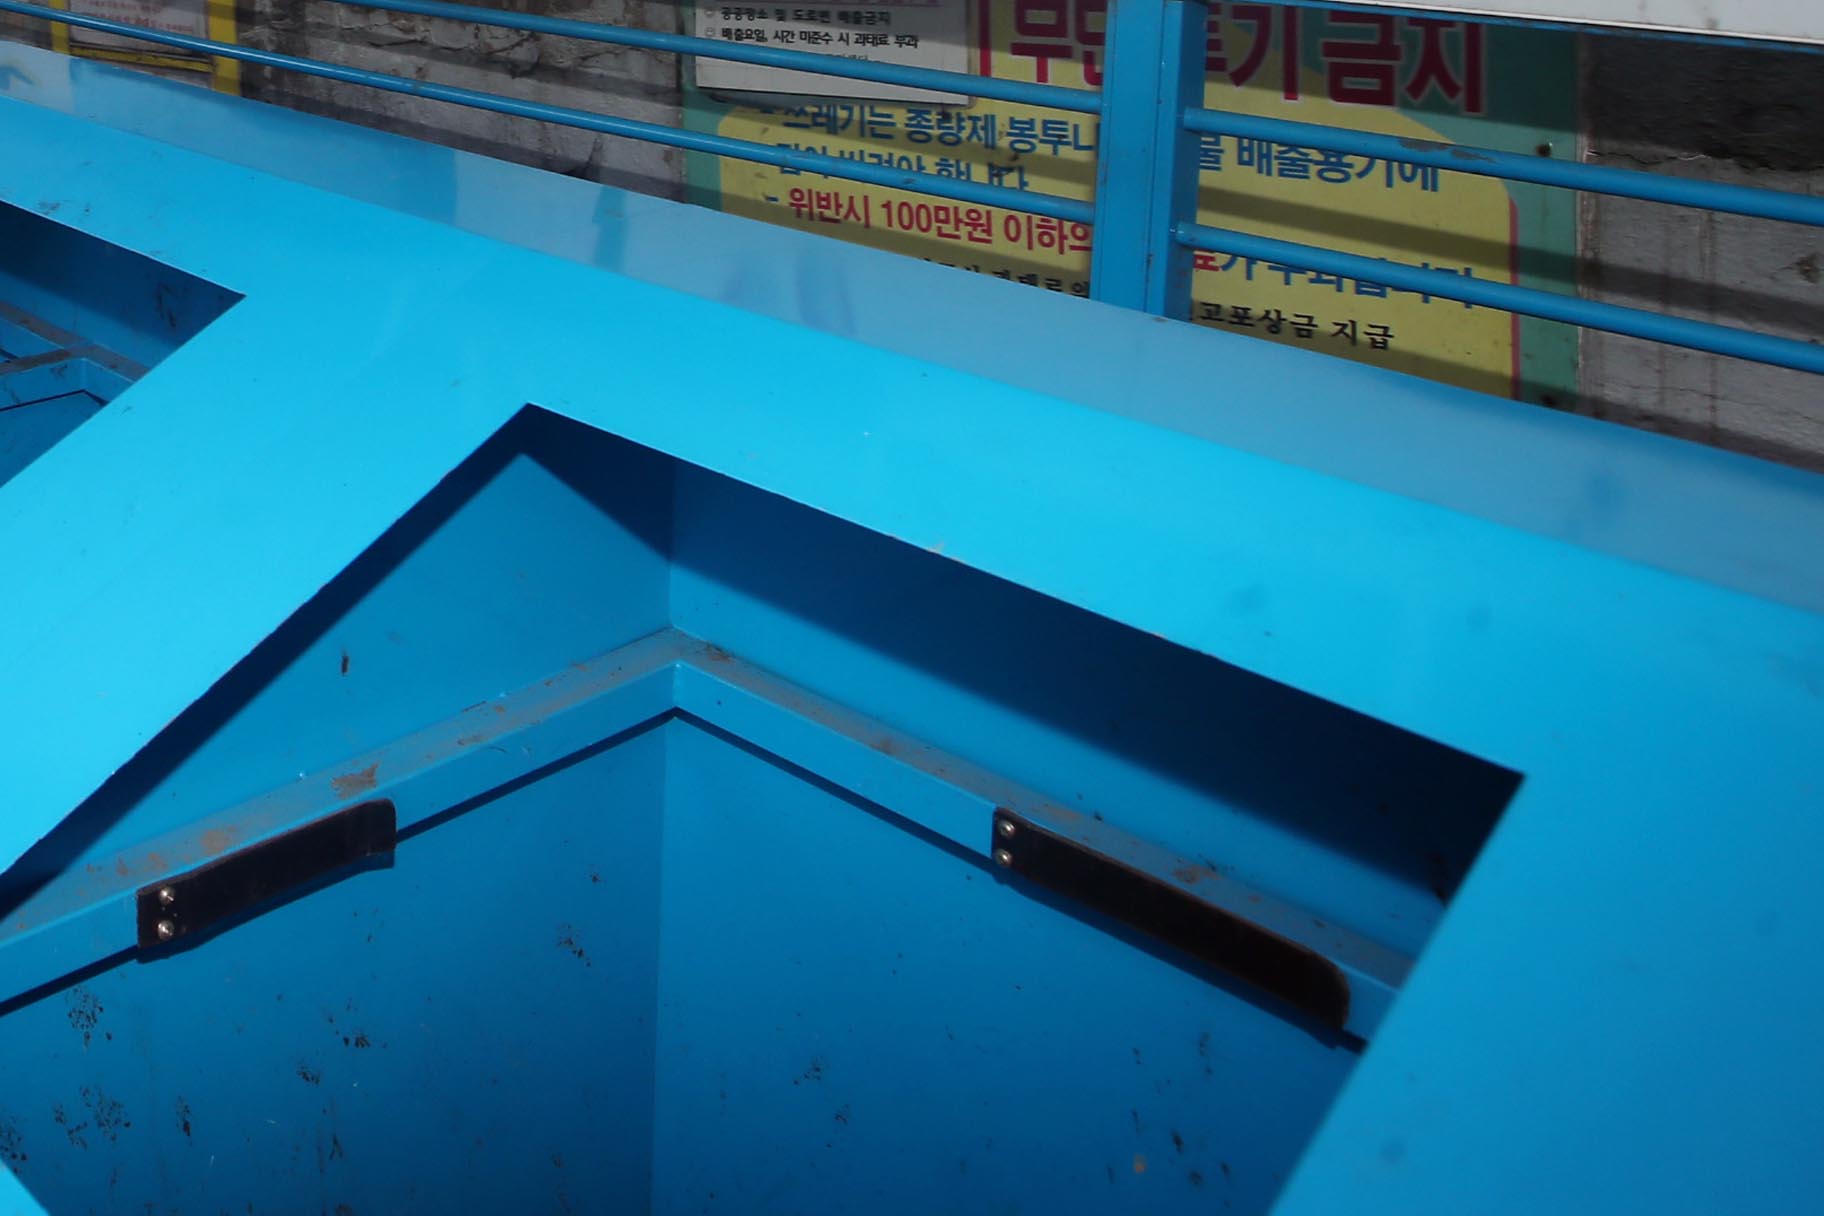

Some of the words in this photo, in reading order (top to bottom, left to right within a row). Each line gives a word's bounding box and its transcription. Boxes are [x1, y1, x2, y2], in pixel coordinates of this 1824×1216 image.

[773, 30, 796, 44] 시간
[799, 30, 833, 45] 미준수
[837, 32, 850, 46] 시
[854, 32, 890, 48] 과태료
[894, 35, 920, 49] 부과
[1321, 10, 1485, 115] 금지
[904, 107, 998, 151] 종량제
[788, 187, 872, 229] 위반시
[881, 199, 993, 245] 100만원
[1189, 301, 1319, 339] 고포상금
[1331, 319, 1396, 351] 지급
